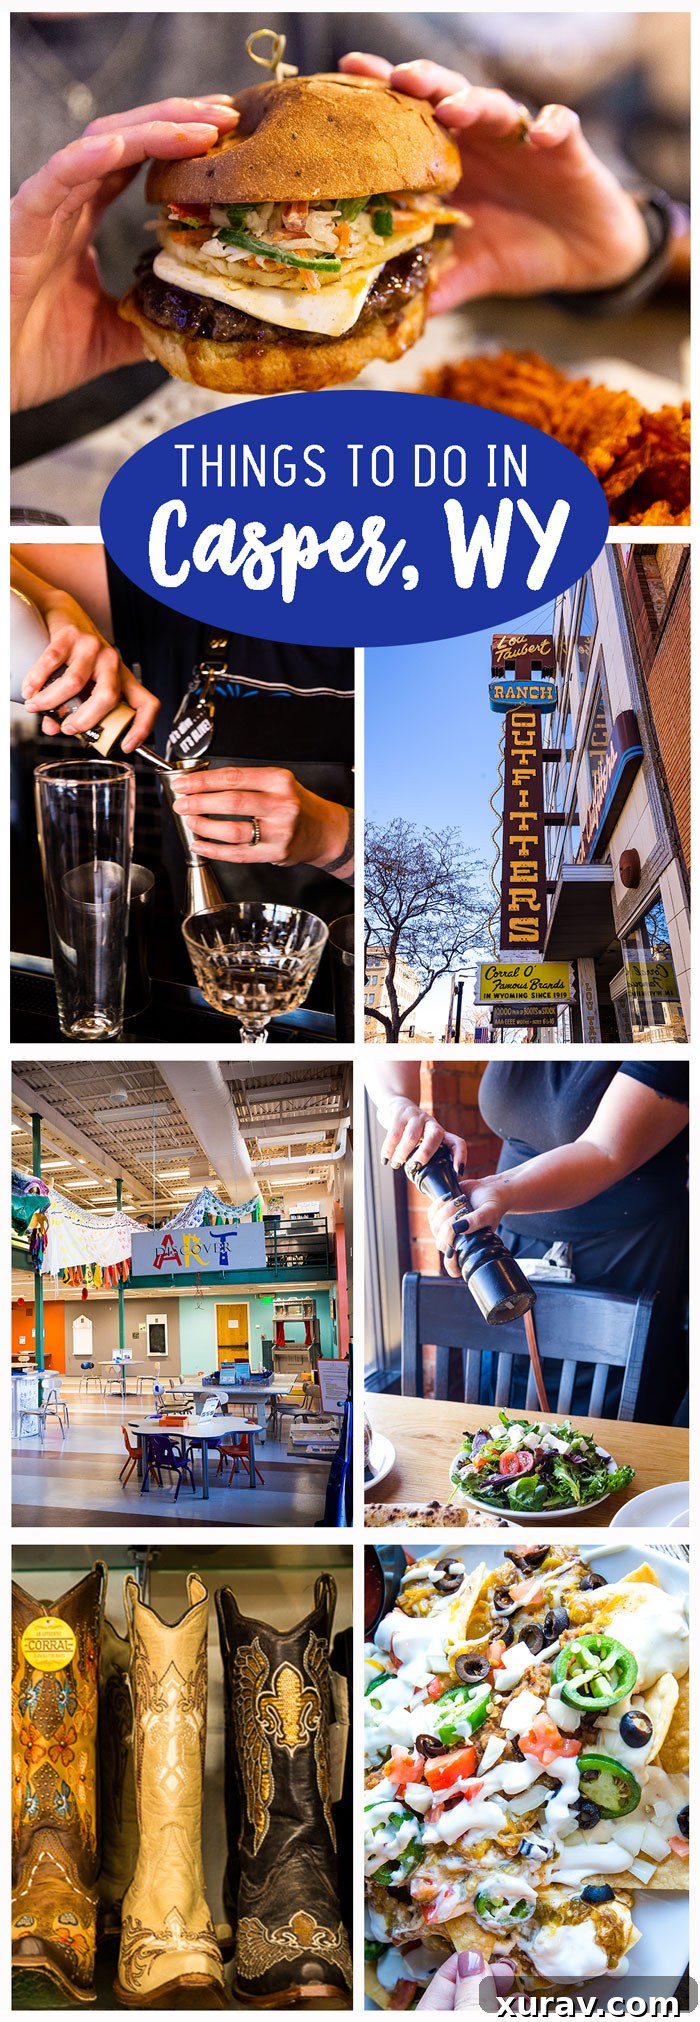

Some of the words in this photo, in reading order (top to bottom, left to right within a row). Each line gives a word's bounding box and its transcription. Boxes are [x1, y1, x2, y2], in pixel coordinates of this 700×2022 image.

[495, 638, 552, 662] Taubert
[497, 635, 528, 650] Lou
[494, 685, 553, 700] RANCH
[508, 712, 541, 943] OUTFITTERS
[484, 965, 520, 980] Corral
[492, 979, 528, 992] Famous
[529, 978, 566, 991] Brands
[553, 991, 567, 999] 1919
[155, 1243, 232, 1256] DISCOVER
[29, 1640, 70, 1650] CORRAL
